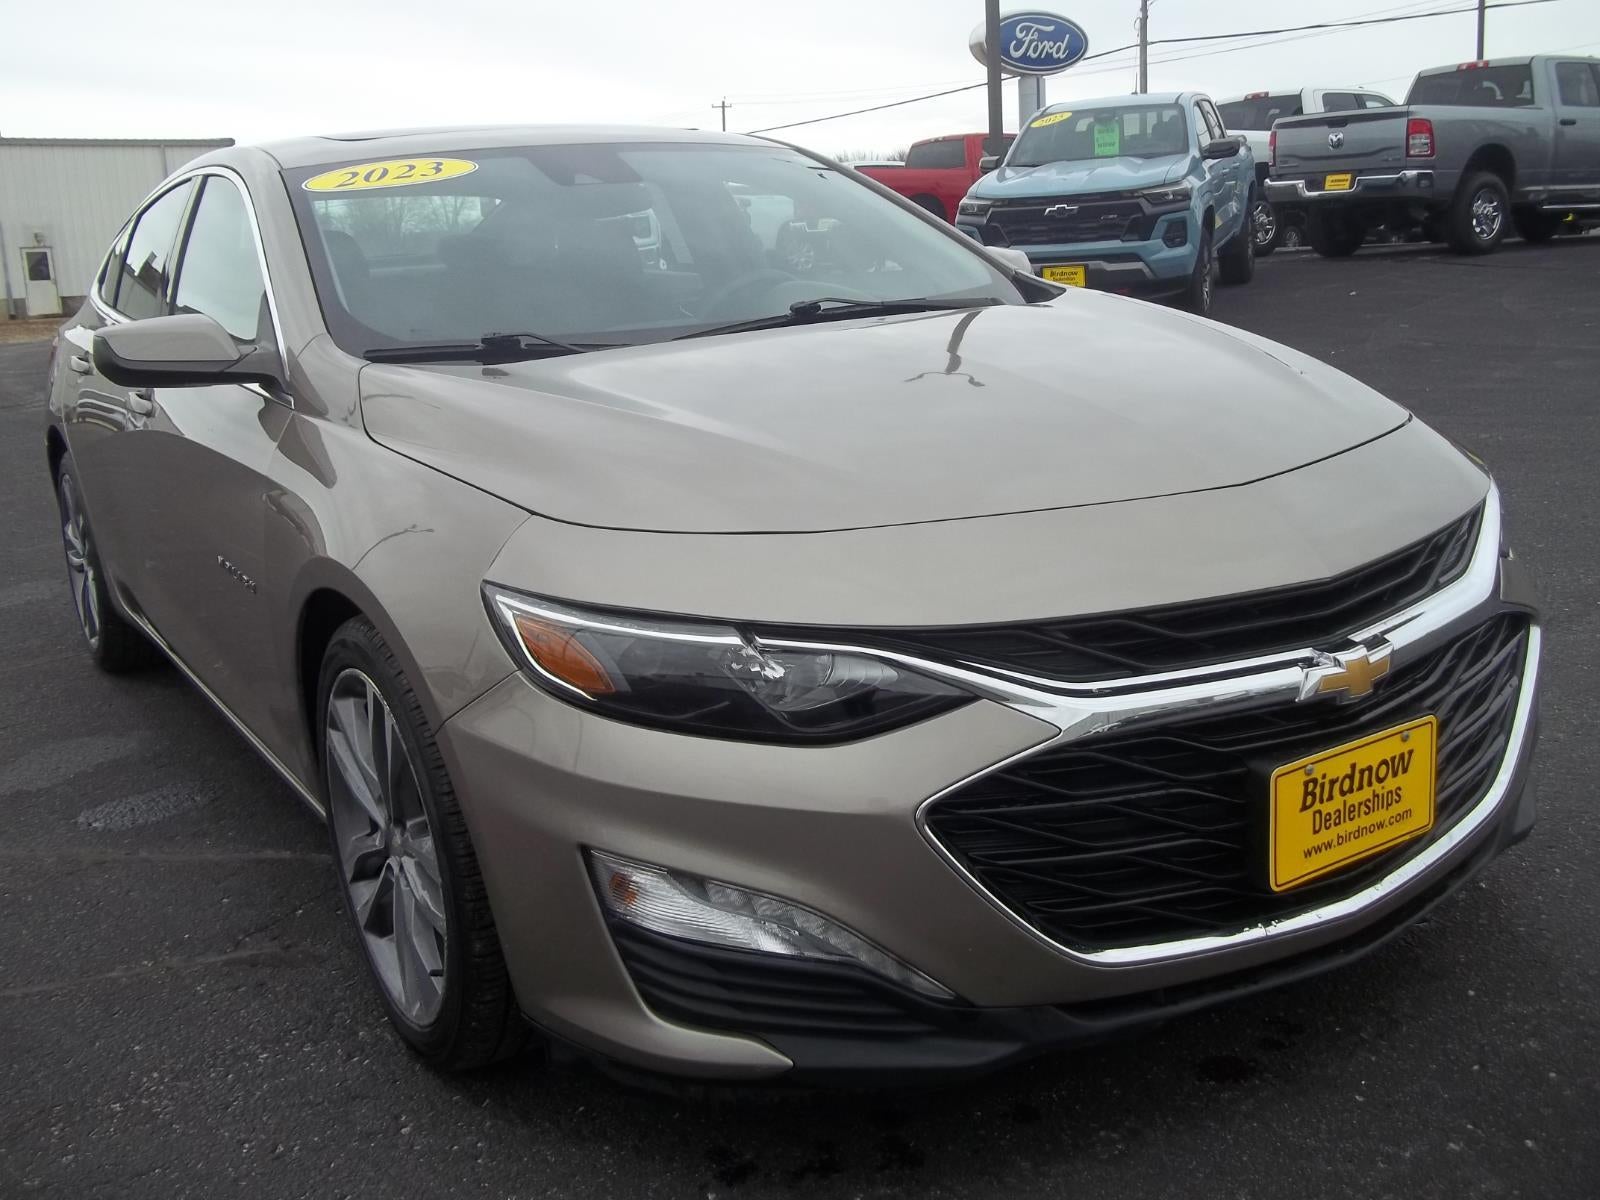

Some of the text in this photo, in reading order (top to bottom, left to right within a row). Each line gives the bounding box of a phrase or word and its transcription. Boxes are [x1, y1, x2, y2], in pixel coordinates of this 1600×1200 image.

[1010, 22, 1069, 59] Ford
[334, 161, 443, 188] 2023
[1299, 749, 1414, 813] Birdnow
[1303, 807, 1412, 859] www.birdnow.com
[1312, 786, 1402, 835] Dealerships
